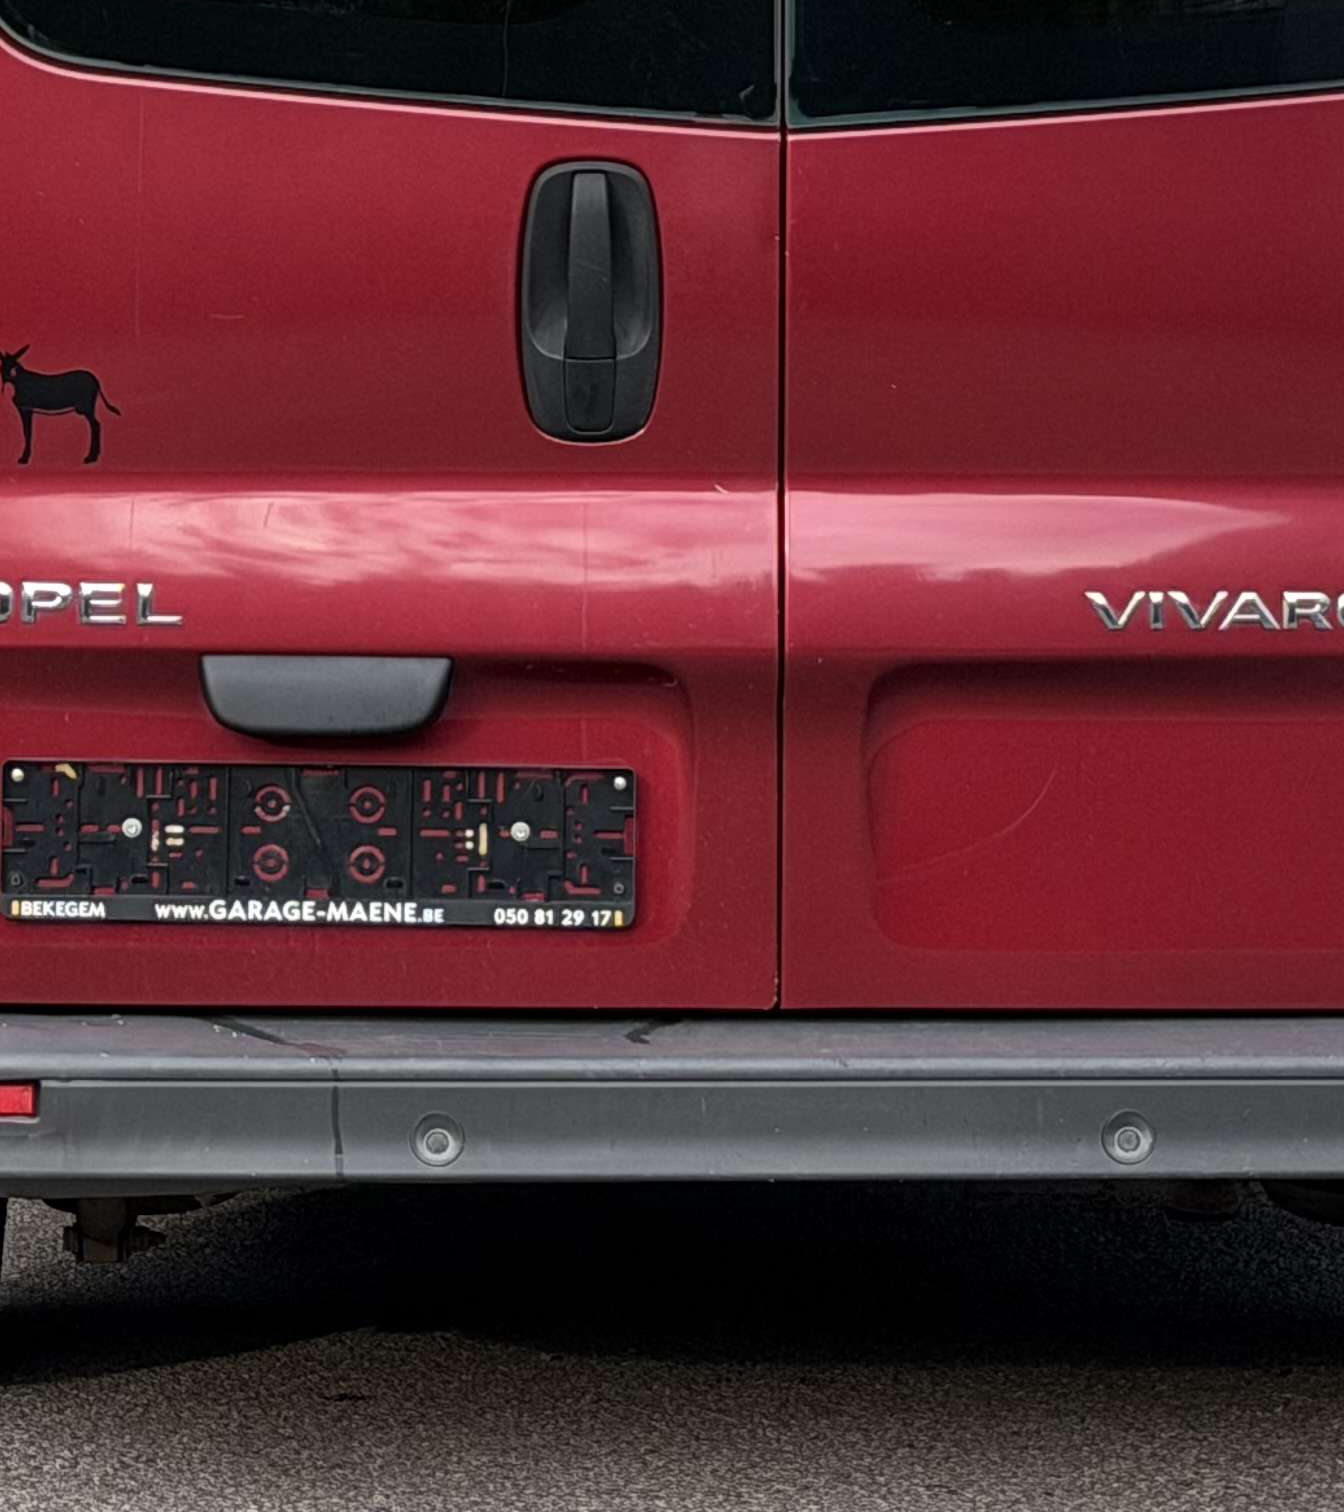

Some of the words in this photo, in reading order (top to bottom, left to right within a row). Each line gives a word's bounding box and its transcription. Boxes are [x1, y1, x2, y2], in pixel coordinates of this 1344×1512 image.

[20, 900, 106, 919] BEKEGEM
[493, 908, 530, 925] 050
[533, 909, 555, 926] 81
[560, 909, 585, 926] 29
[591, 910, 611, 927] 17
